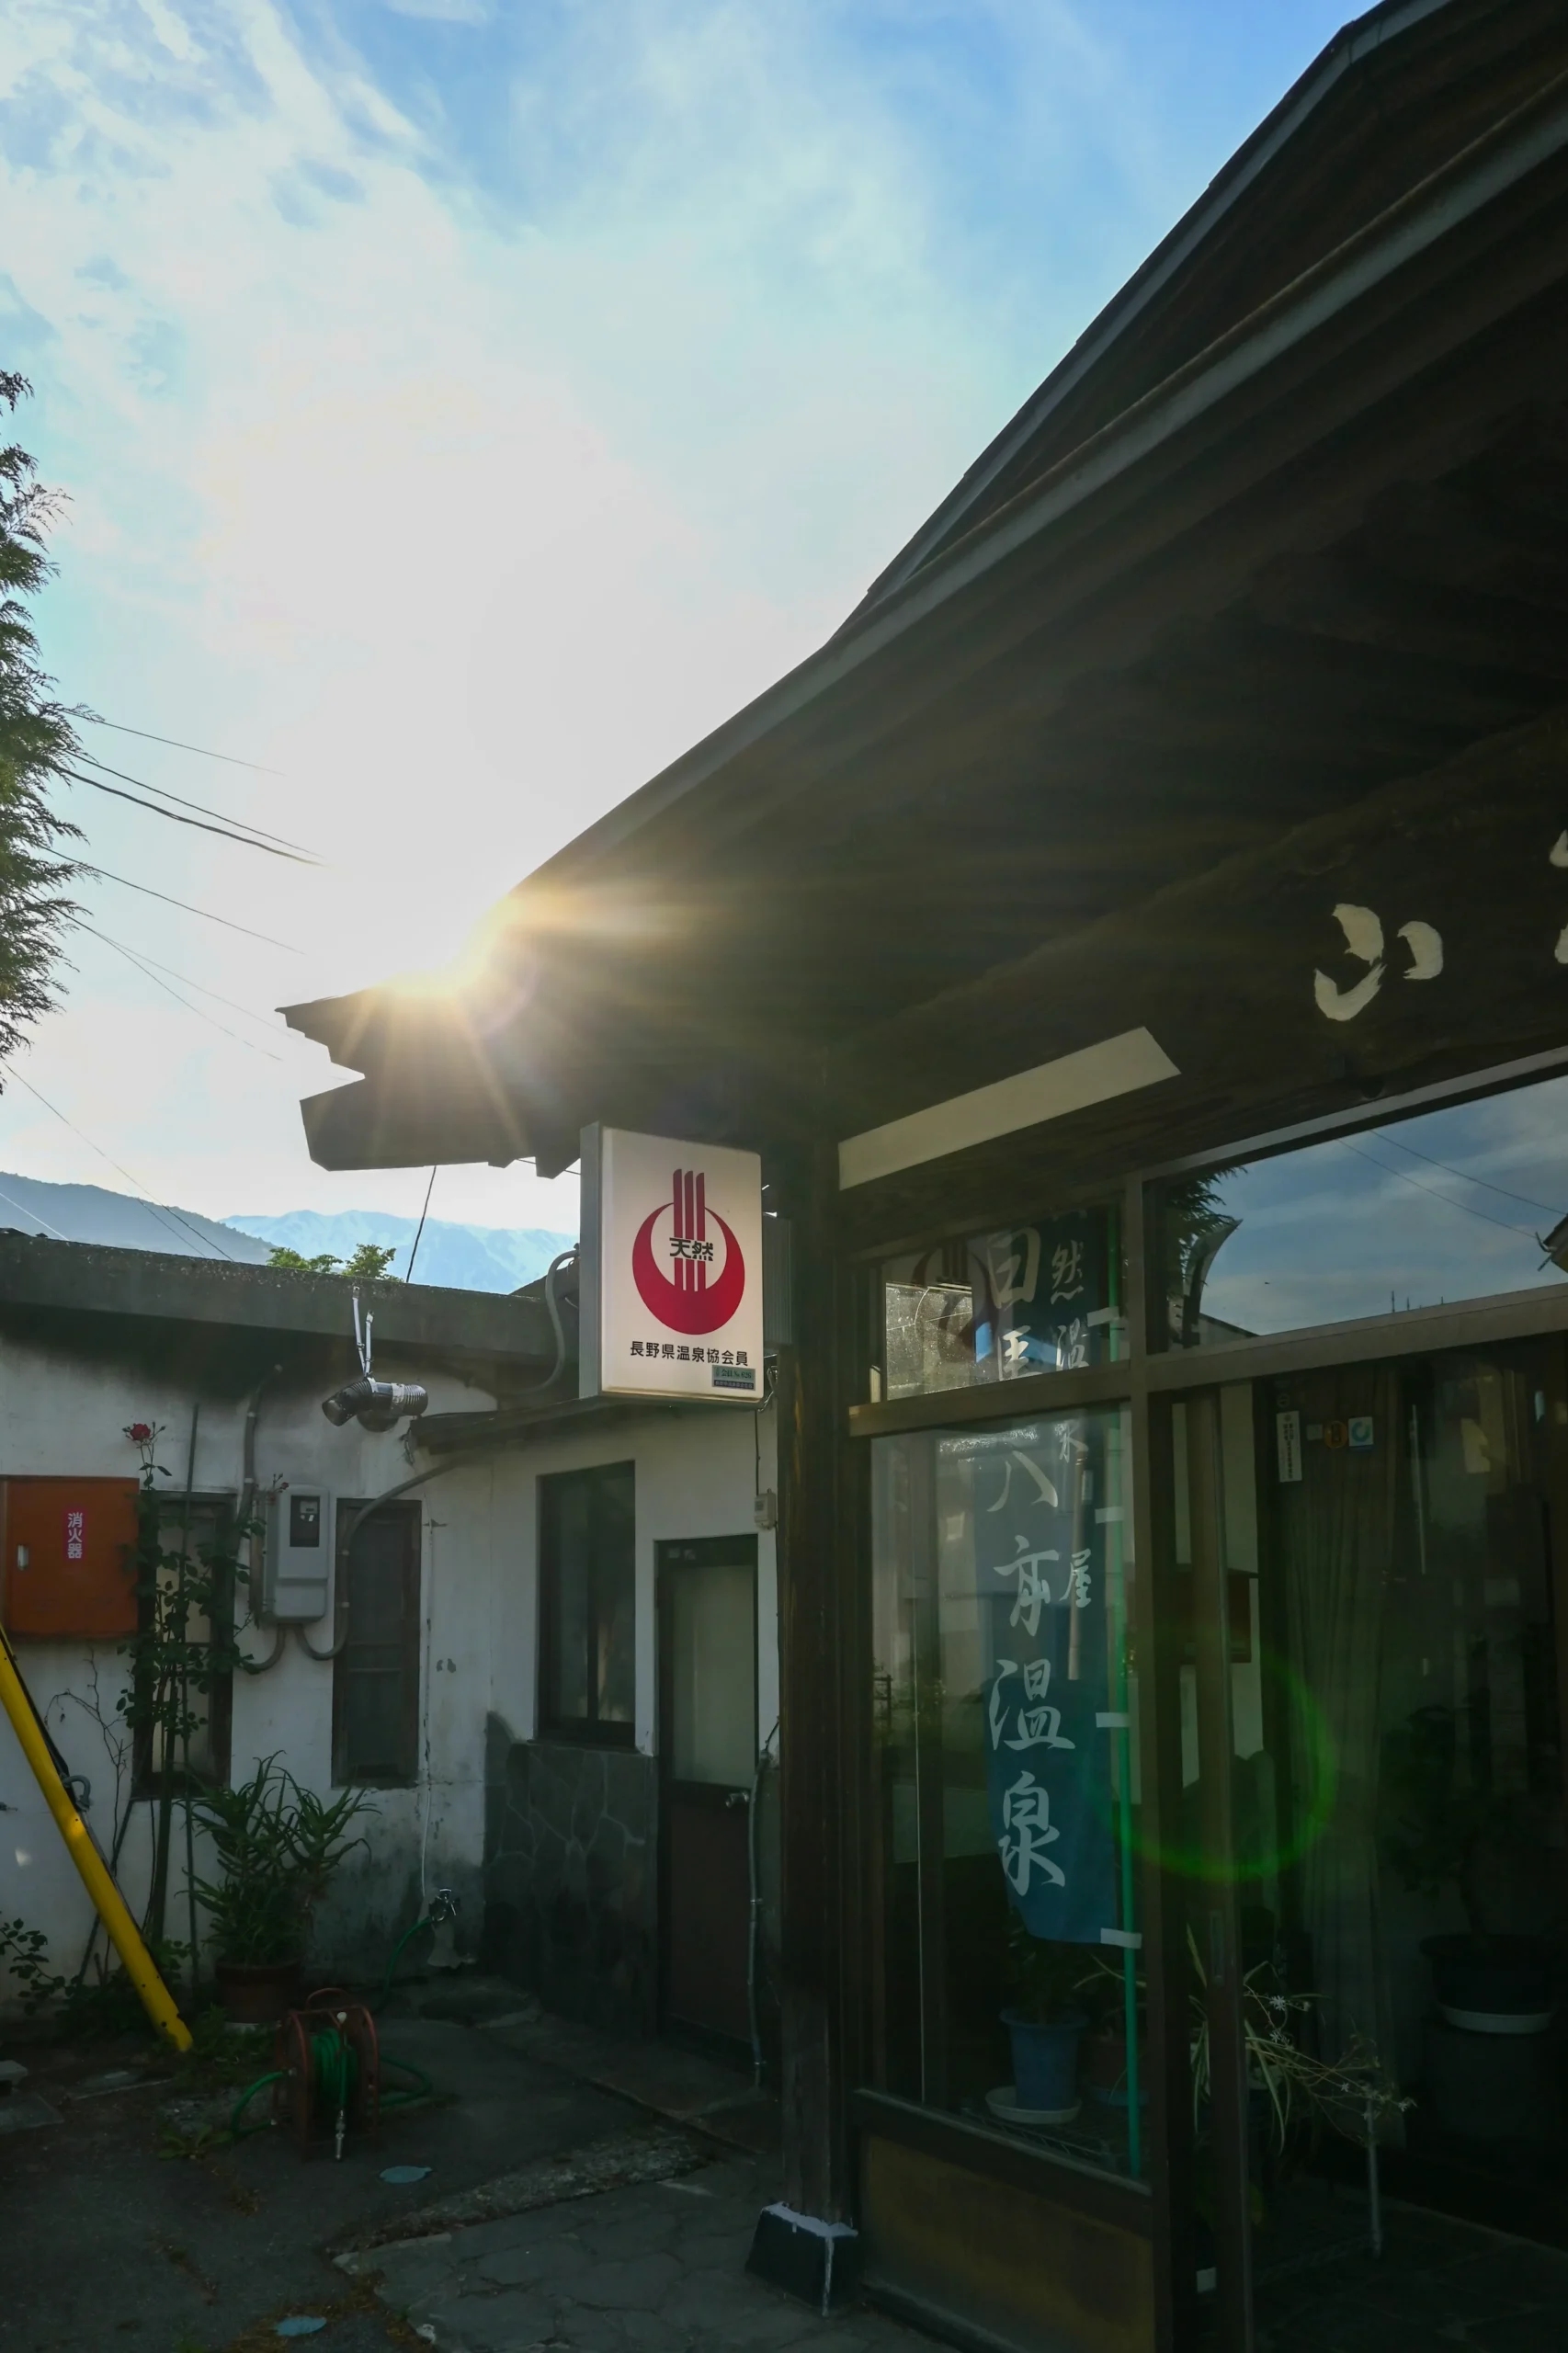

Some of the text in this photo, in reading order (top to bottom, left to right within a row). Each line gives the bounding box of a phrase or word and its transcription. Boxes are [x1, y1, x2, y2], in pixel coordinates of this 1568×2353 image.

[669, 1237, 714, 1262] 天然
[630, 1340, 748, 1367] 長野県温泉協会員
[67, 1511, 84, 1559] 消火器
